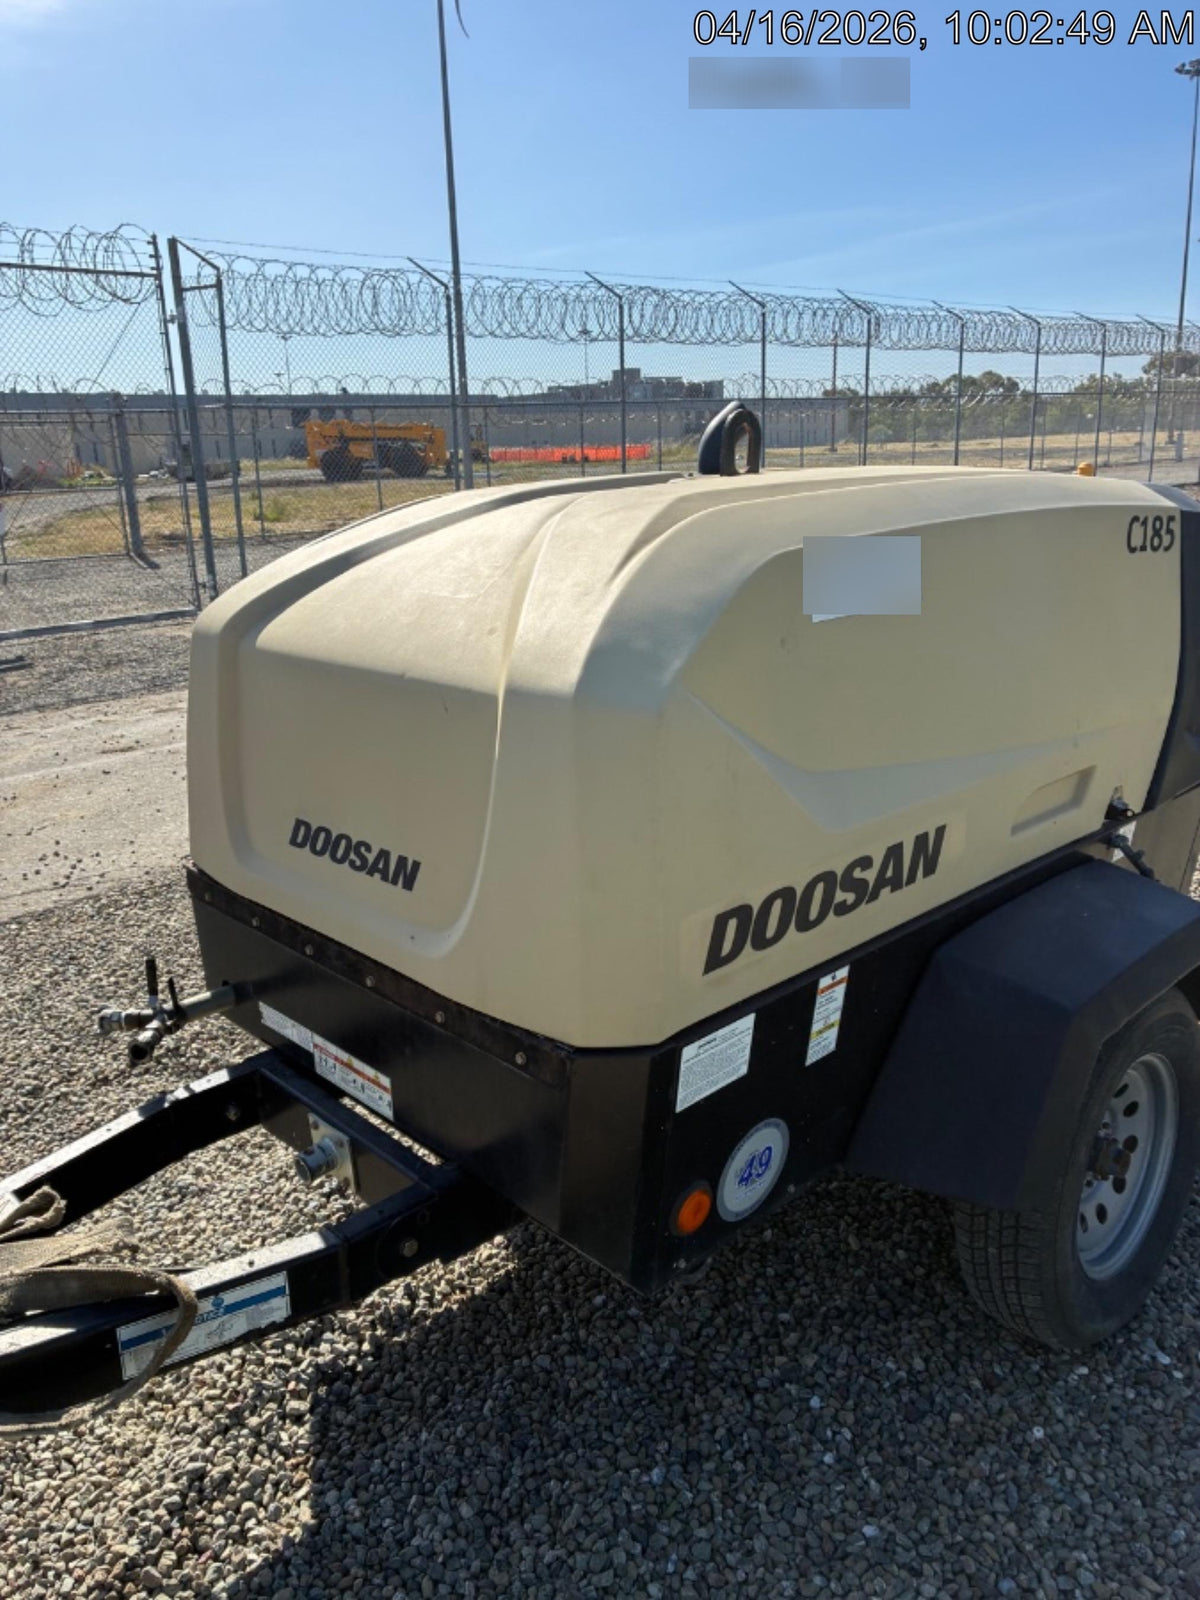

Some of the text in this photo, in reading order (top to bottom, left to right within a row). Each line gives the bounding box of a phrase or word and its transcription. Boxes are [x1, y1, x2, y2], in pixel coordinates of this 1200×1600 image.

[1127, 515, 1176, 553] C185
[289, 817, 422, 892] DOOSAN
[702, 824, 947, 976] DOOSAN
